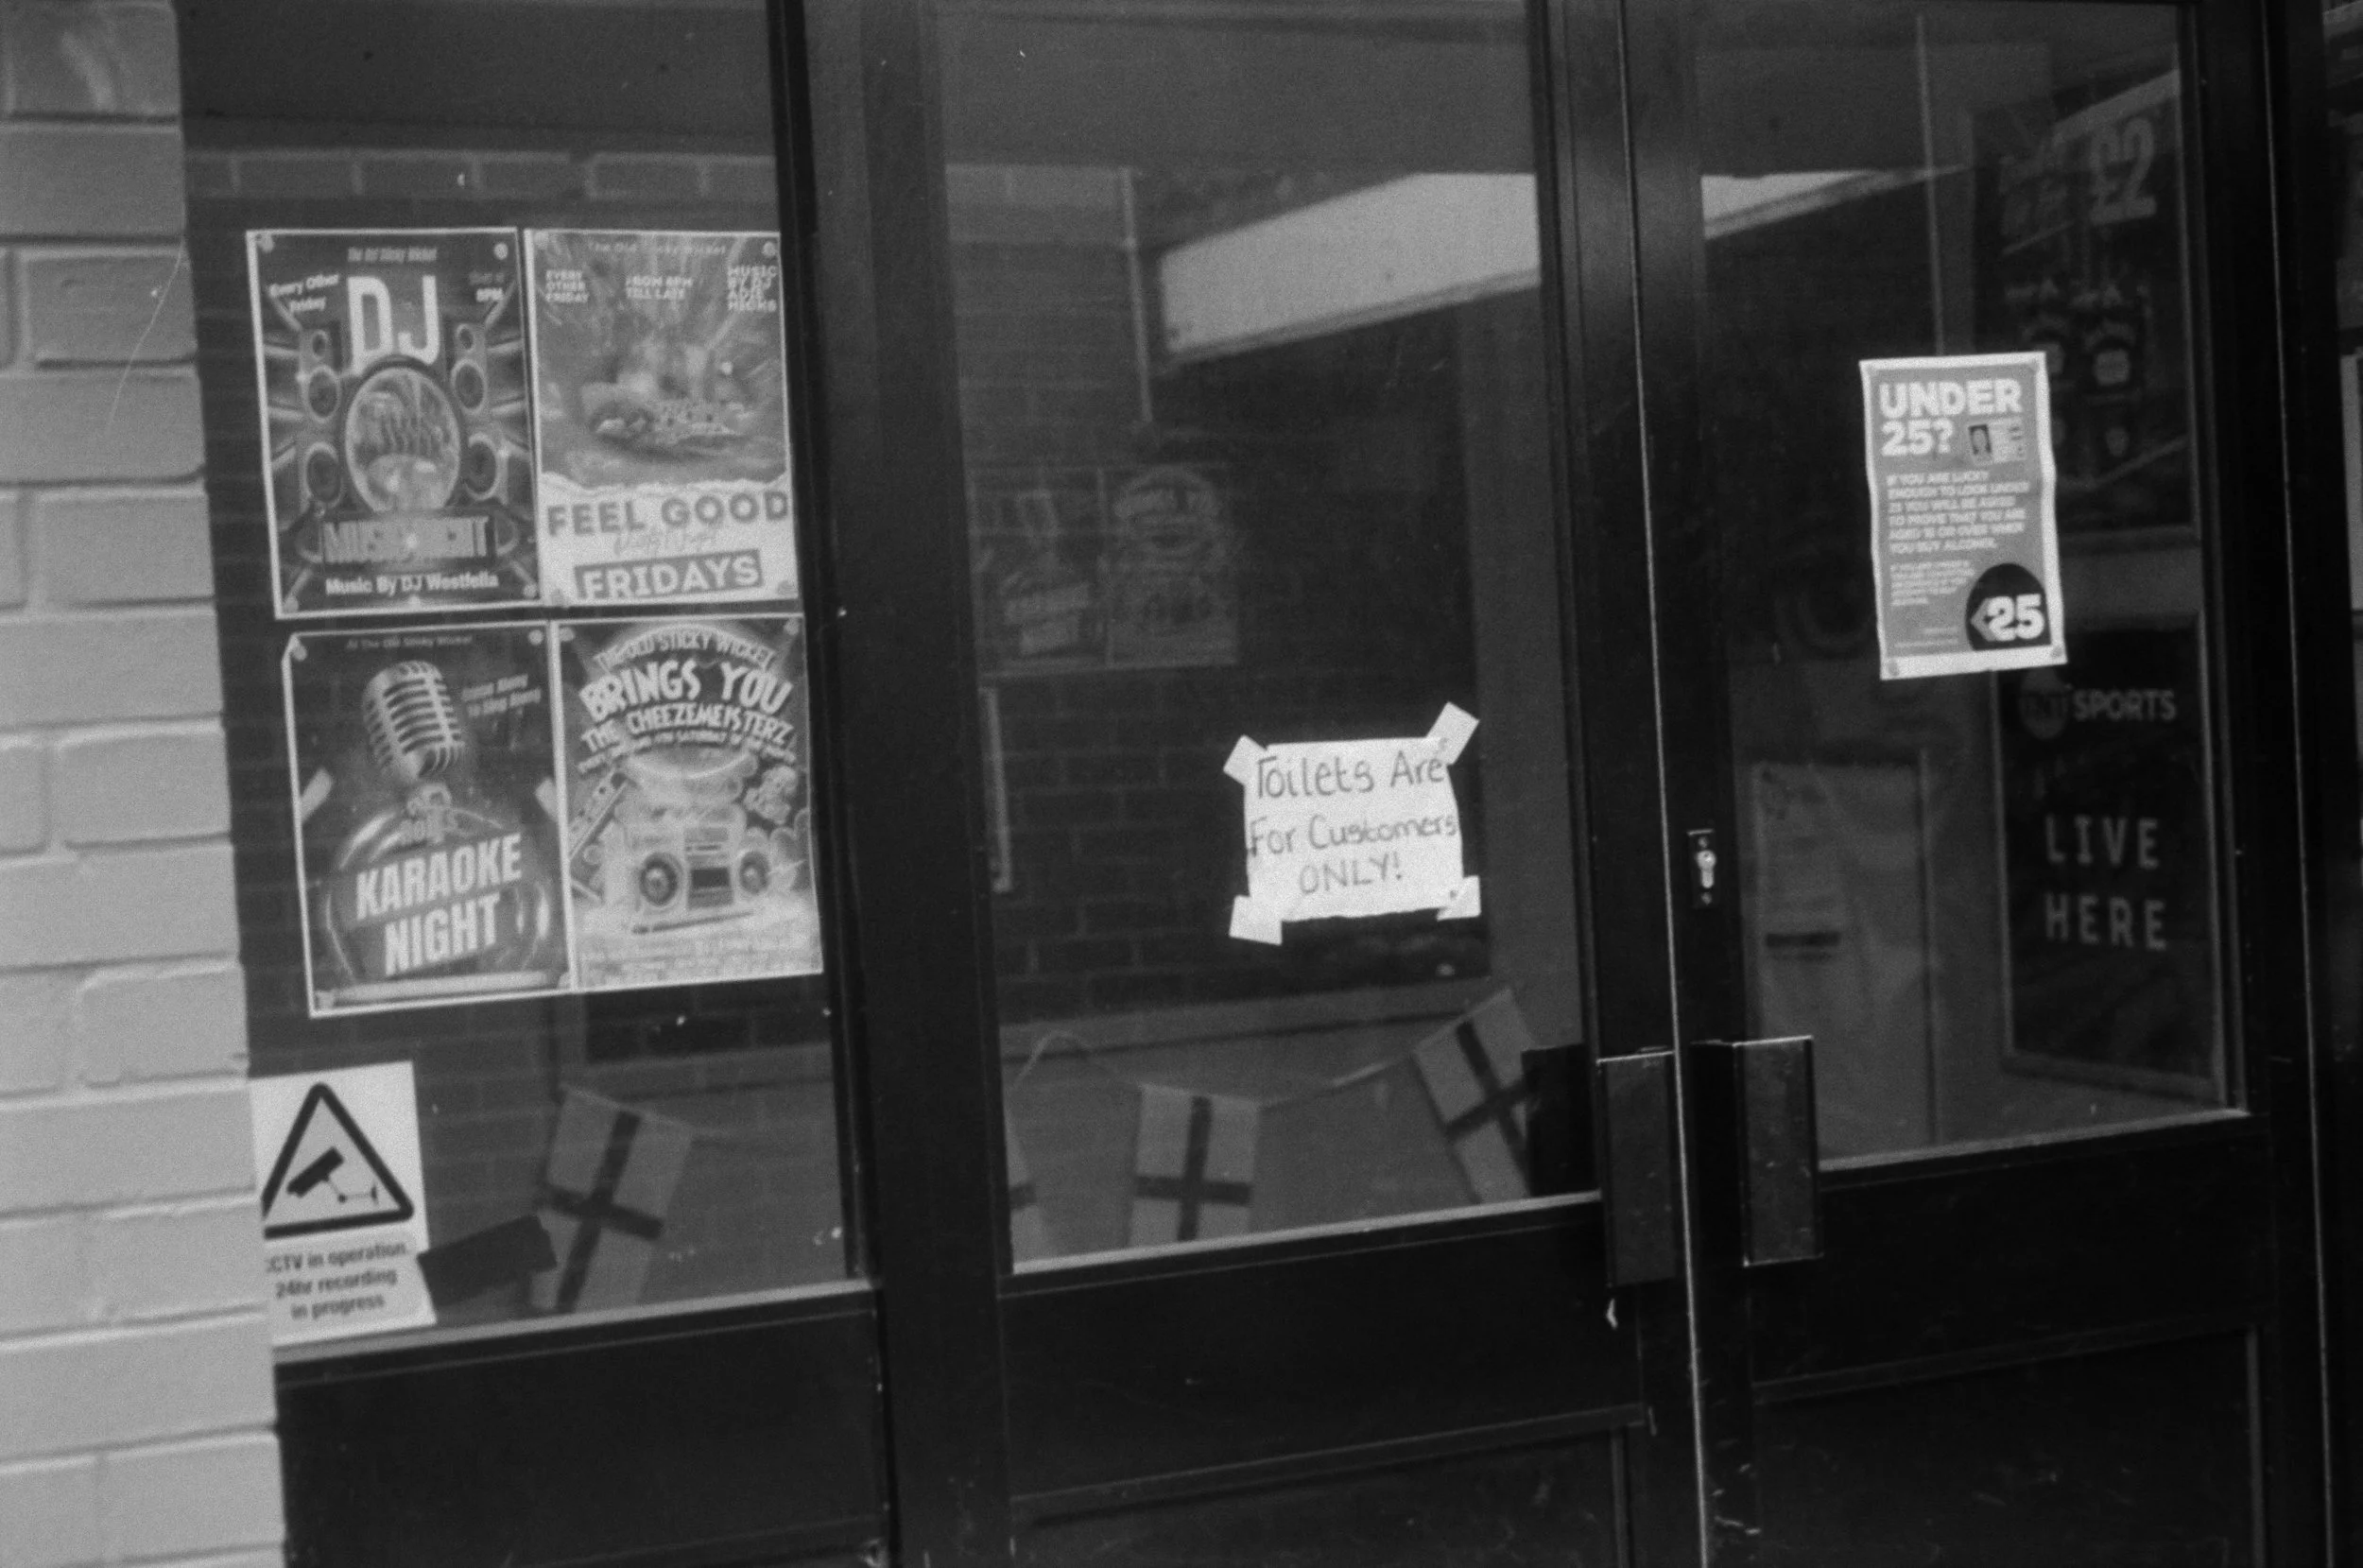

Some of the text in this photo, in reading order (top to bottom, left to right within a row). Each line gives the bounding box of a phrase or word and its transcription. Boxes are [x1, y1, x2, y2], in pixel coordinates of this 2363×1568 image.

[347, 274, 440, 378] DJ
[1879, 378, 2023, 419] UNDER
[1881, 417, 1954, 457] 25?
[547, 490, 789, 538] FEEL GOOD
[325, 576, 373, 595] Music
[375, 574, 397, 597] By
[401, 573, 423, 593] DJ
[582, 555, 761, 599] FRIDAYS
[1987, 593, 2045, 642] 25
[579, 659, 701, 722] BRINGS
[720, 661, 794, 715] YOU
[2073, 687, 2177, 723] SPORTS
[581, 718, 622, 753] THE
[1256, 750, 1446, 799] Toilets Are
[1249, 813, 1458, 858] For Customers
[2044, 813, 2161, 870] LIVE
[355, 832, 523, 922] KARAOKE
[1299, 851, 1404, 894] ONLY!
[385, 891, 501, 977] NIGHT
[2044, 891, 2168, 953] HERE
[306, 1251, 324, 1268] in
[327, 1243, 406, 1268] operation
[318, 1269, 398, 1295] recording
[290, 1294, 386, 1320] in progress
